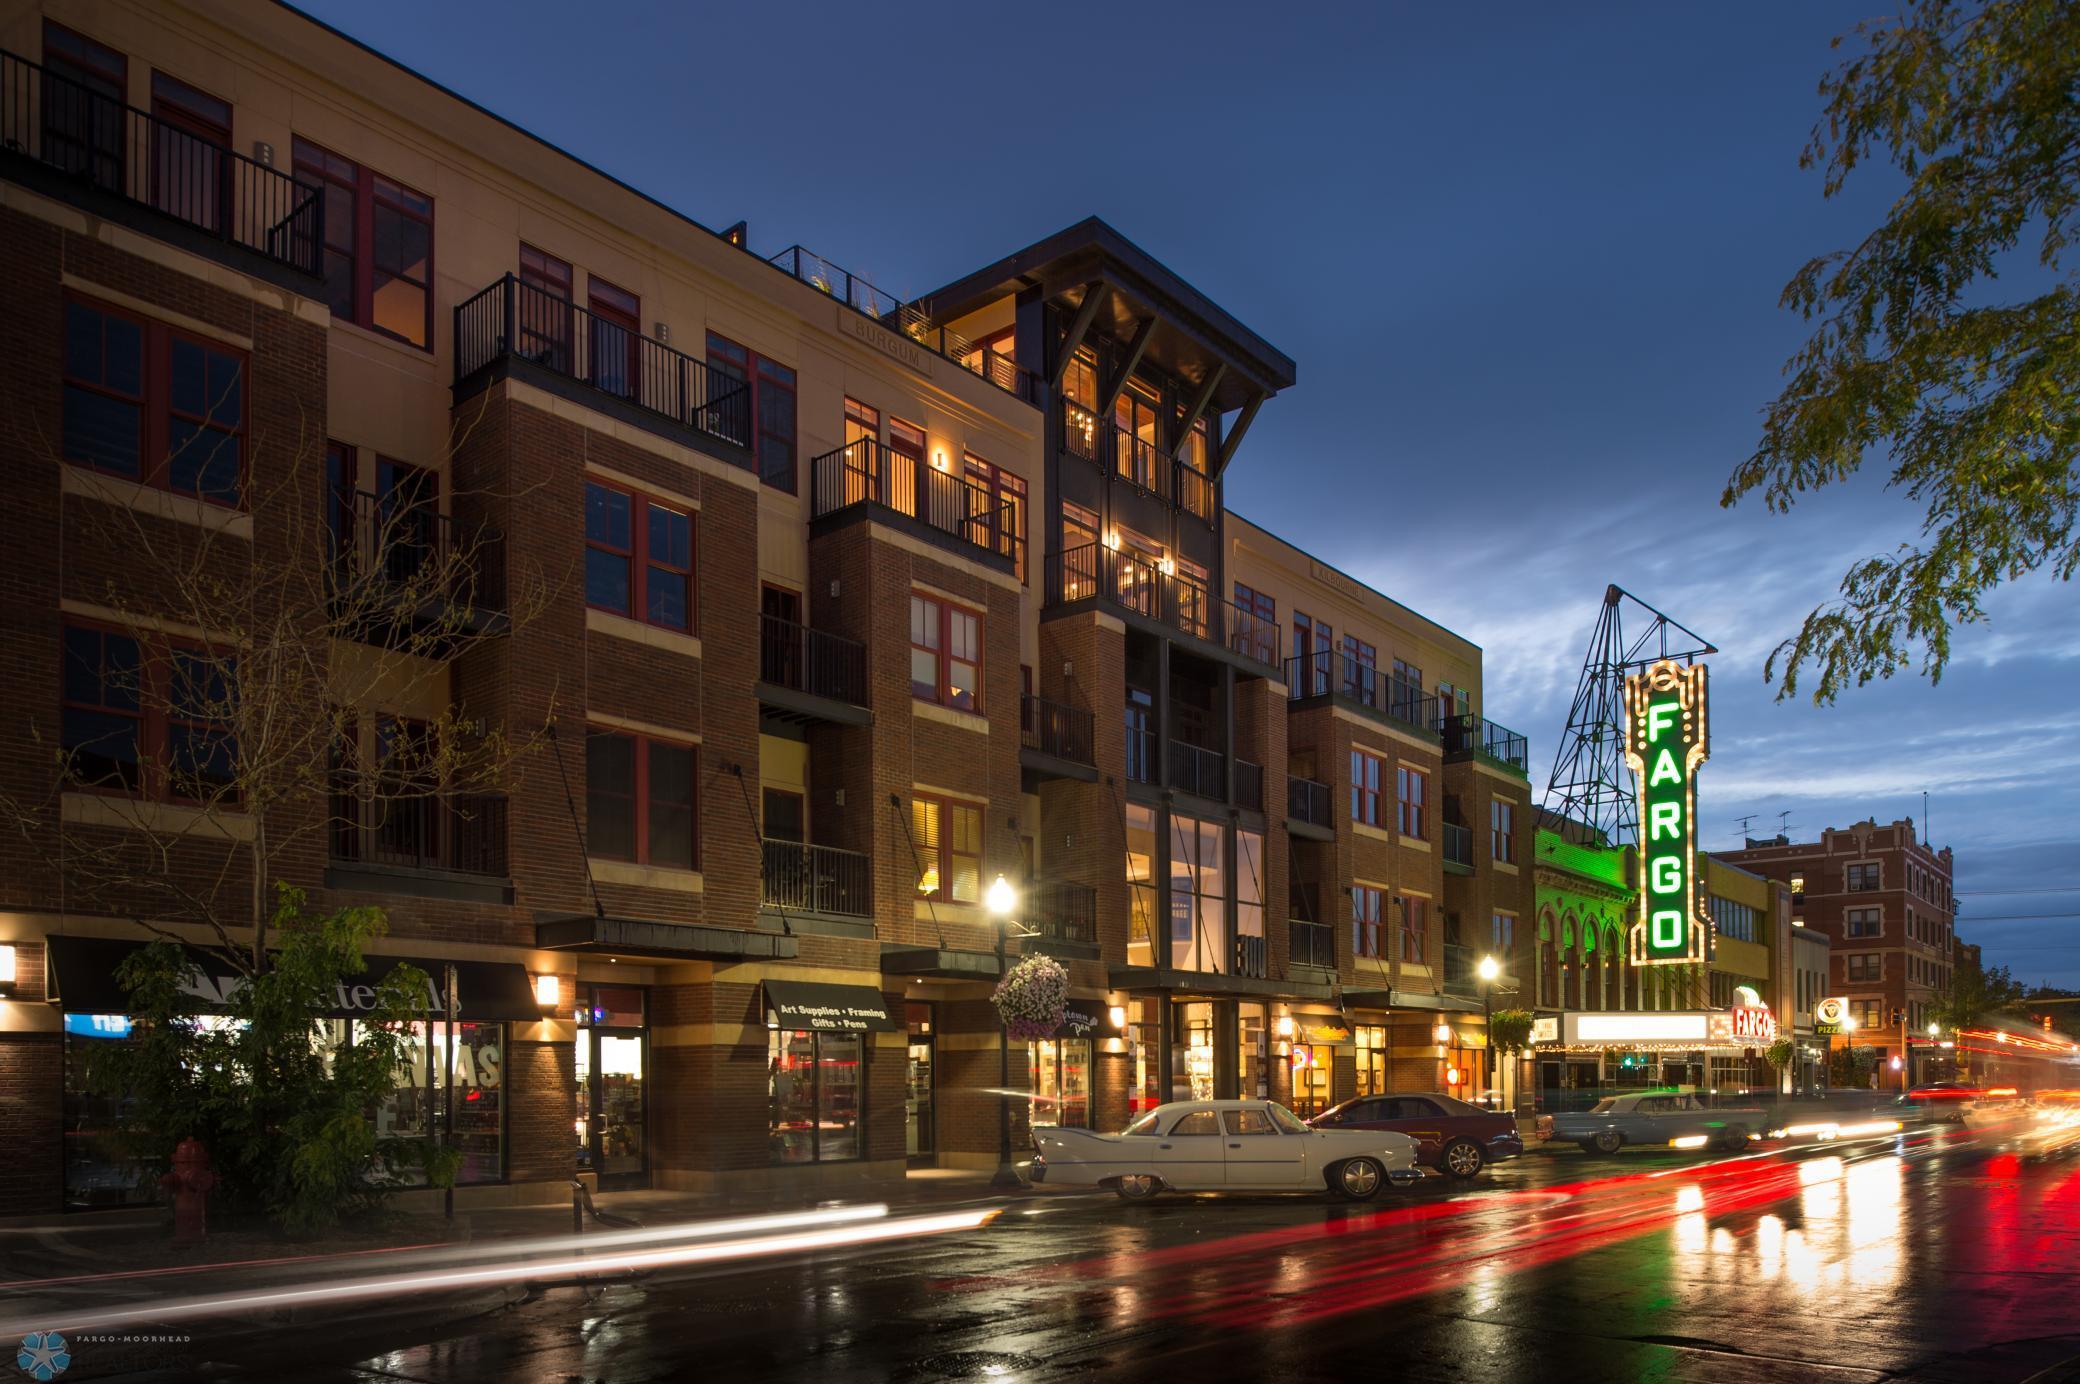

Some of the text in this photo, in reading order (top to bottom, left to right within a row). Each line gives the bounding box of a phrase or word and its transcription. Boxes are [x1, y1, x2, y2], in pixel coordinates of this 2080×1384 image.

[855, 319, 920, 367] BURGUM
[1647, 701, 1682, 949] FARGO
[781, 1004, 887, 1020] Art Supplies Framing
[1063, 1009, 1089, 1024] ptown
[811, 1018, 868, 1029] Gifts Pens
[1736, 1009, 1771, 1038] FARGO
